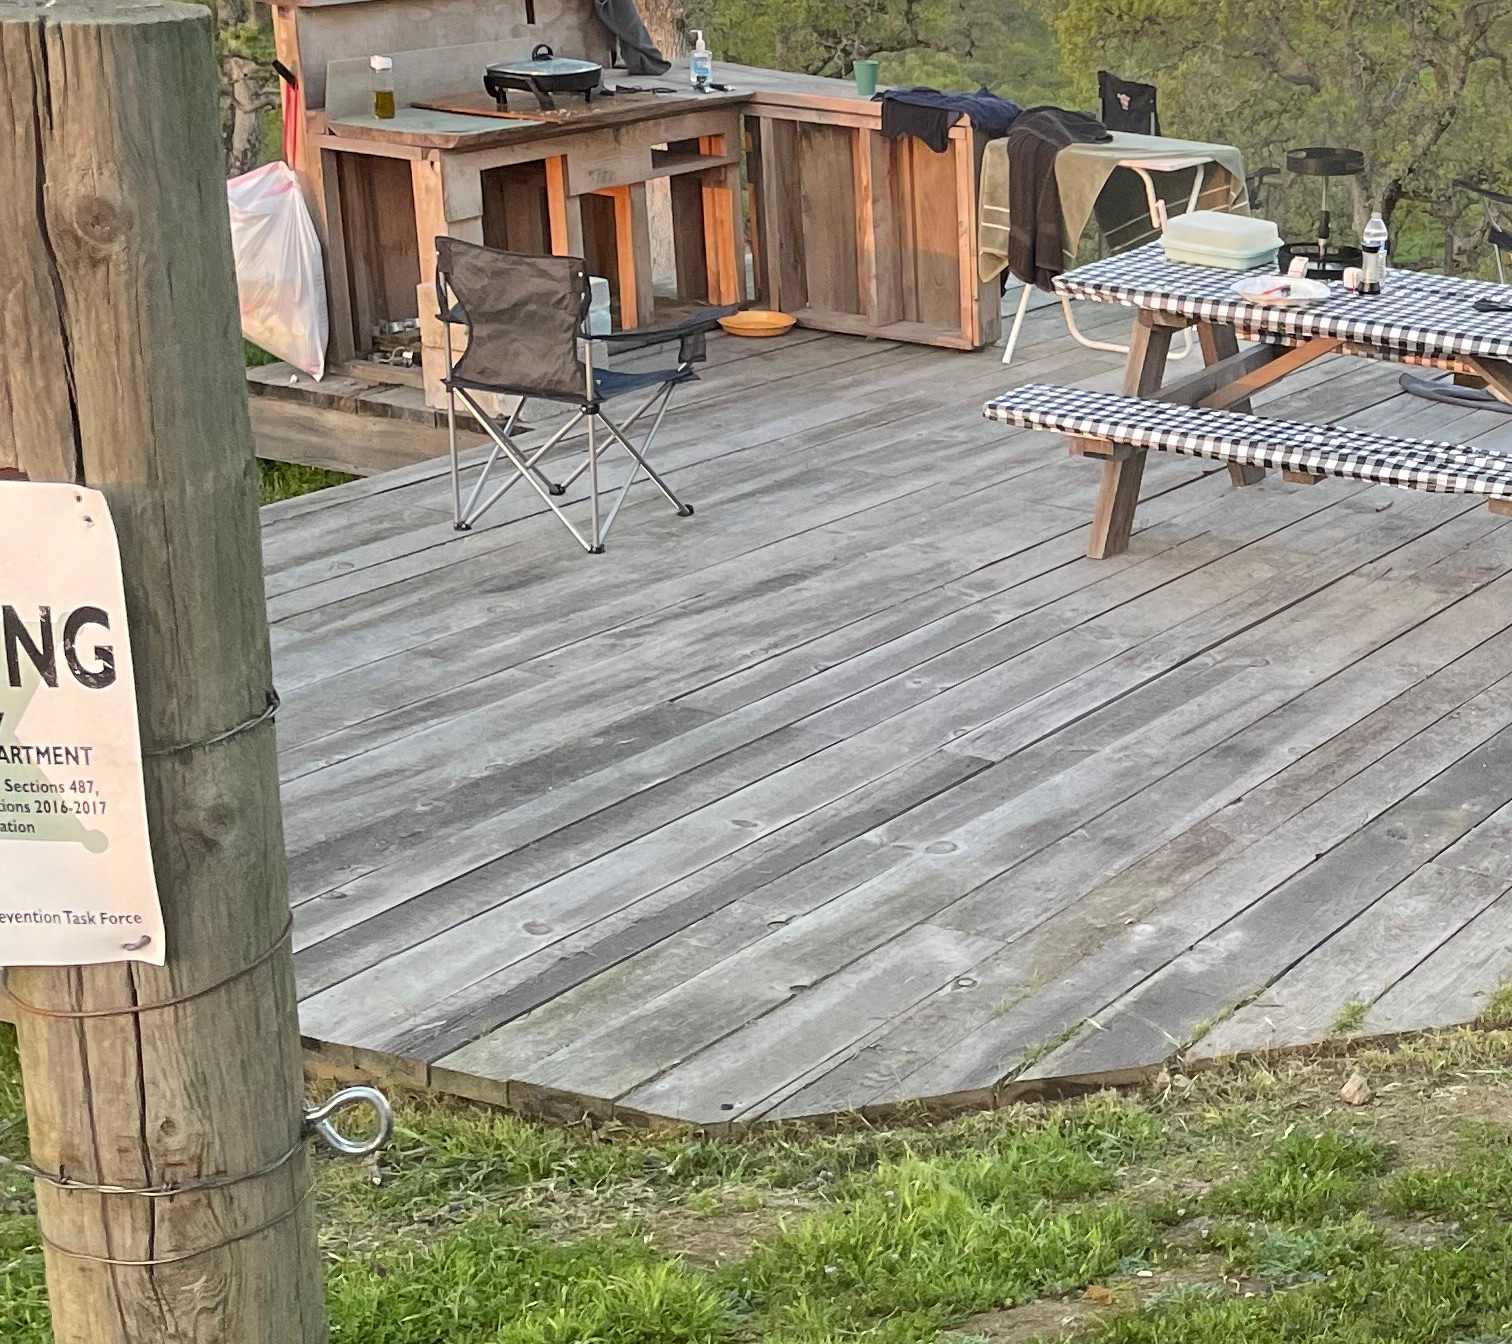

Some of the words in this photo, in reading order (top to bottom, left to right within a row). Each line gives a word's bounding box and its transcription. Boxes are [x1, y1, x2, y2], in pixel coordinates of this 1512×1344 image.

[2, 605, 116, 689] NG
[4, 778, 65, 794] Sections
[69, 779, 99, 797] 487,
[34, 799, 107, 815] 2016-2017
[62, 910, 97, 925] Task
[100, 912, 143, 925] Force
